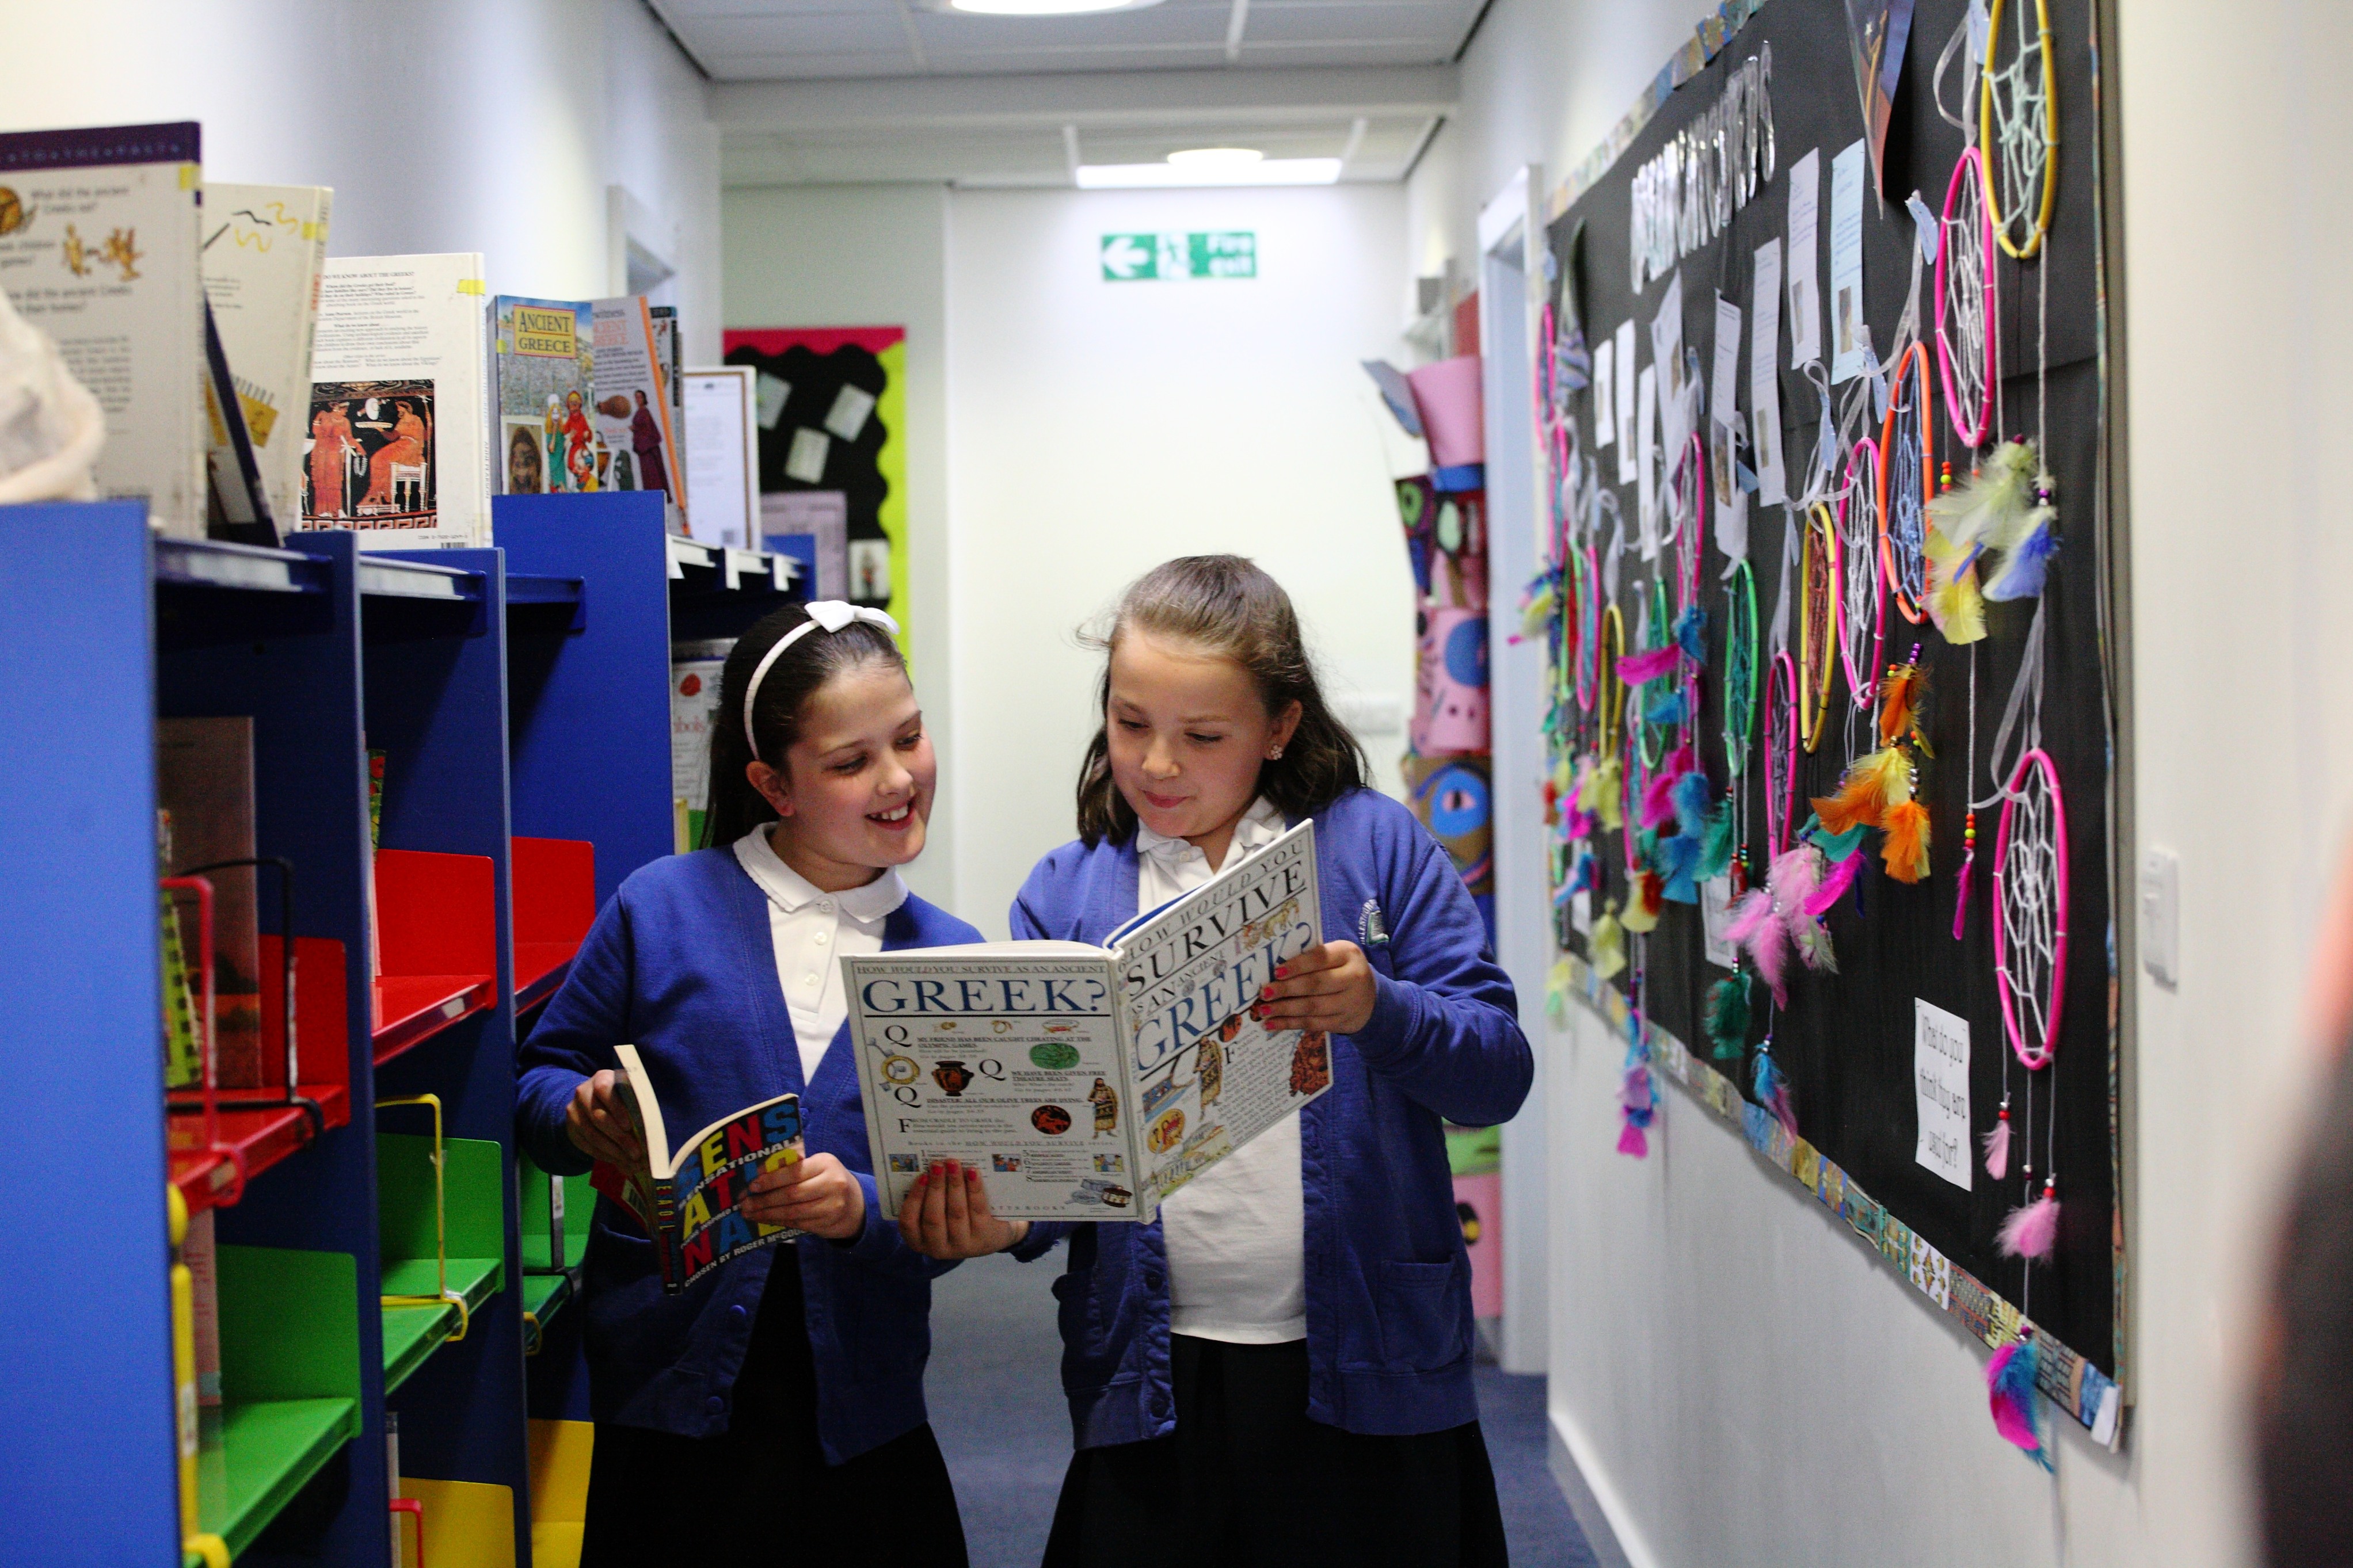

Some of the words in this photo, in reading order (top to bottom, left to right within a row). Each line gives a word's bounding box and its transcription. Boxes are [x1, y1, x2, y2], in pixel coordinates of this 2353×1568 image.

[519, 311, 571, 333] ANCIENT
[519, 337, 571, 353] GREECE
[1128, 920, 1171, 959] HOW
[1179, 873, 1251, 928] WOULD
[1261, 840, 1304, 873] YOU
[1127, 860, 1305, 997] SURVIVE
[932, 966, 958, 974] YOU
[961, 966, 1011, 974] SURVIVE
[1052, 965, 1106, 973] ANCIENT
[863, 979, 1106, 1012] GREEK?
[1135, 921, 1313, 1071] GREEK?
[1148, 981, 1176, 1013] AN
[884, 1025, 911, 1047] Q
[1921, 1013, 1938, 1049] What
[1939, 1023, 1948, 1055] do
[1949, 1037, 1964, 1067] you
[978, 1059, 1006, 1081] Q
[894, 1086, 921, 1108] Q
[1920, 1067, 1937, 1101] think
[1938, 1076, 1951, 1119] they
[1952, 1093, 1966, 1119] are
[1929, 1126, 1942, 1159] used
[1942, 1131, 1957, 1169] for?
[677, 1135, 801, 1212] SENSATIONAL!
[684, 1260, 718, 1288] CHOSEN
[719, 1252, 731, 1264] BY
[733, 1238, 765, 1256] ROGER
